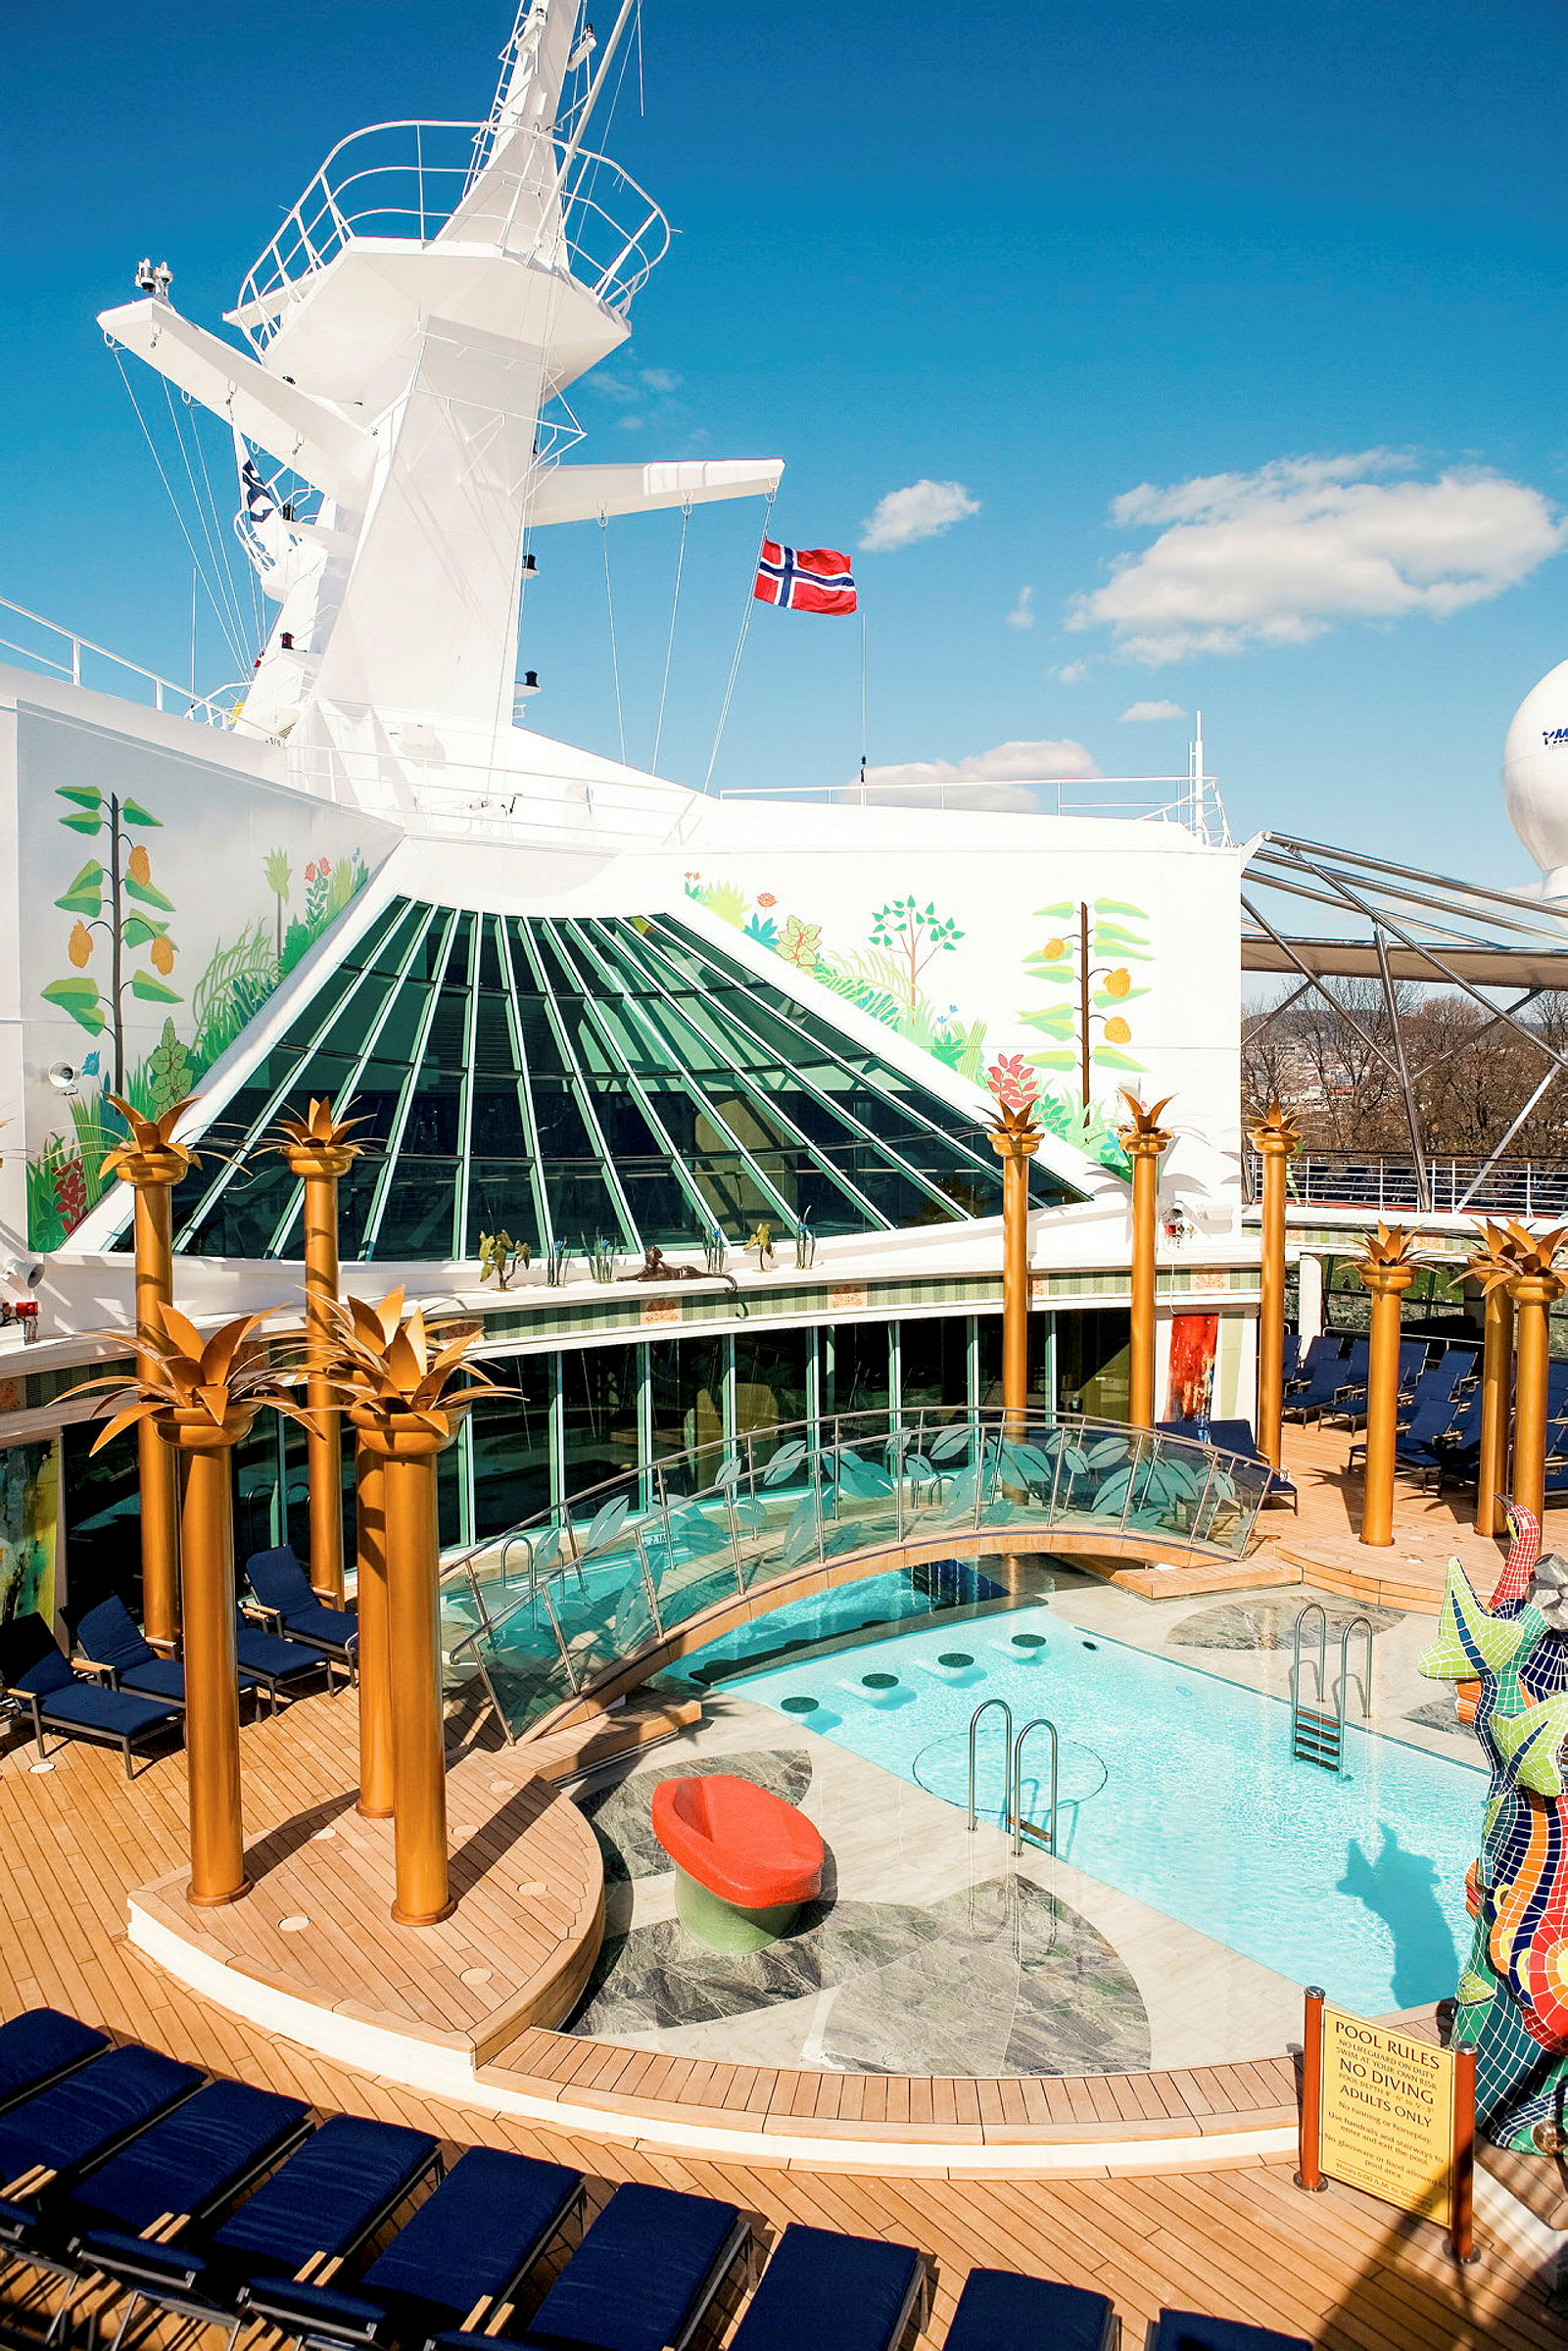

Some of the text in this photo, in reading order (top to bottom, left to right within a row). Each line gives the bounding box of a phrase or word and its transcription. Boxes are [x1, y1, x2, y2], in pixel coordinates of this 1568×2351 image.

[1336, 2022, 1439, 2070] POOL RULES
[1340, 2039, 1435, 2080] NO LIFEGUARD ON DUTY
[1337, 2047, 1357, 2059] SWIM
[1372, 2061, 1394, 2073] YOUR
[1398, 2070, 1418, 2083] OWN
[1420, 2079, 1437, 2089] RISK
[1340, 2074, 1357, 2085] POOL
[1361, 2082, 1382, 2093] DEPTH
[1341, 2058, 1433, 2104] NO DIVING
[1341, 2084, 1431, 2128] ADULTS ONLY
[1353, 2108, 1380, 2125] running
[1329, 2112, 1342, 2121] Use
[1345, 2118, 1377, 2135] handrails
[1380, 2133, 1394, 2142] and
[1397, 2139, 1432, 2158] stairways
[1341, 2125, 1359, 2135] enter
[1362, 2134, 1376, 2143] and
[1379, 2140, 1392, 2149] exit
[1396, 2147, 1407, 2156] the
[1337, 2163, 1355, 2175] Hours
[1338, 2139, 1373, 2158] glassware
[1387, 2159, 1403, 2171] food
[1366, 2159, 1382, 2170] pool
